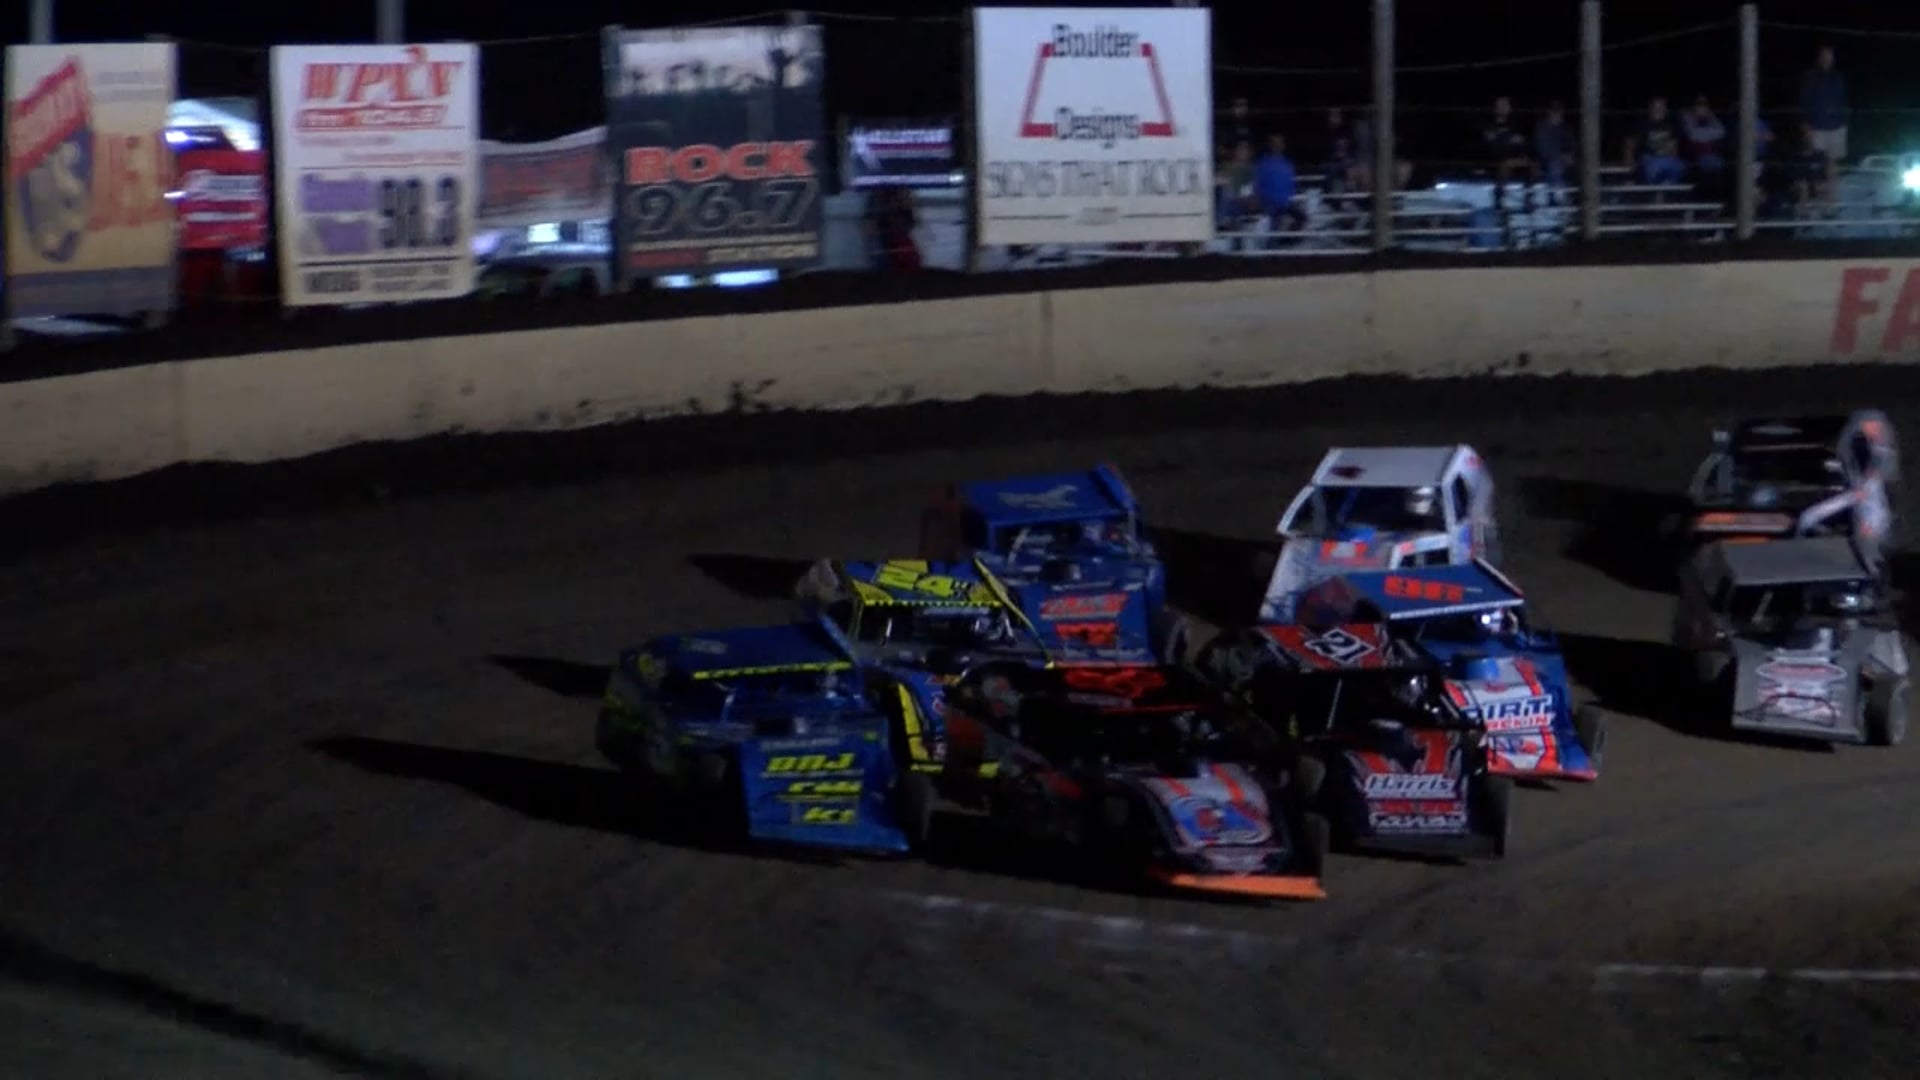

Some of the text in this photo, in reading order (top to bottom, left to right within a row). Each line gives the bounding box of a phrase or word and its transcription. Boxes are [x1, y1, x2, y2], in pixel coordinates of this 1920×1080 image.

[1052, 24, 1138, 57] Boulder
[1054, 107, 1140, 148] Designs
[625, 140, 817, 185] ROCK
[627, 178, 817, 235] 96.7
